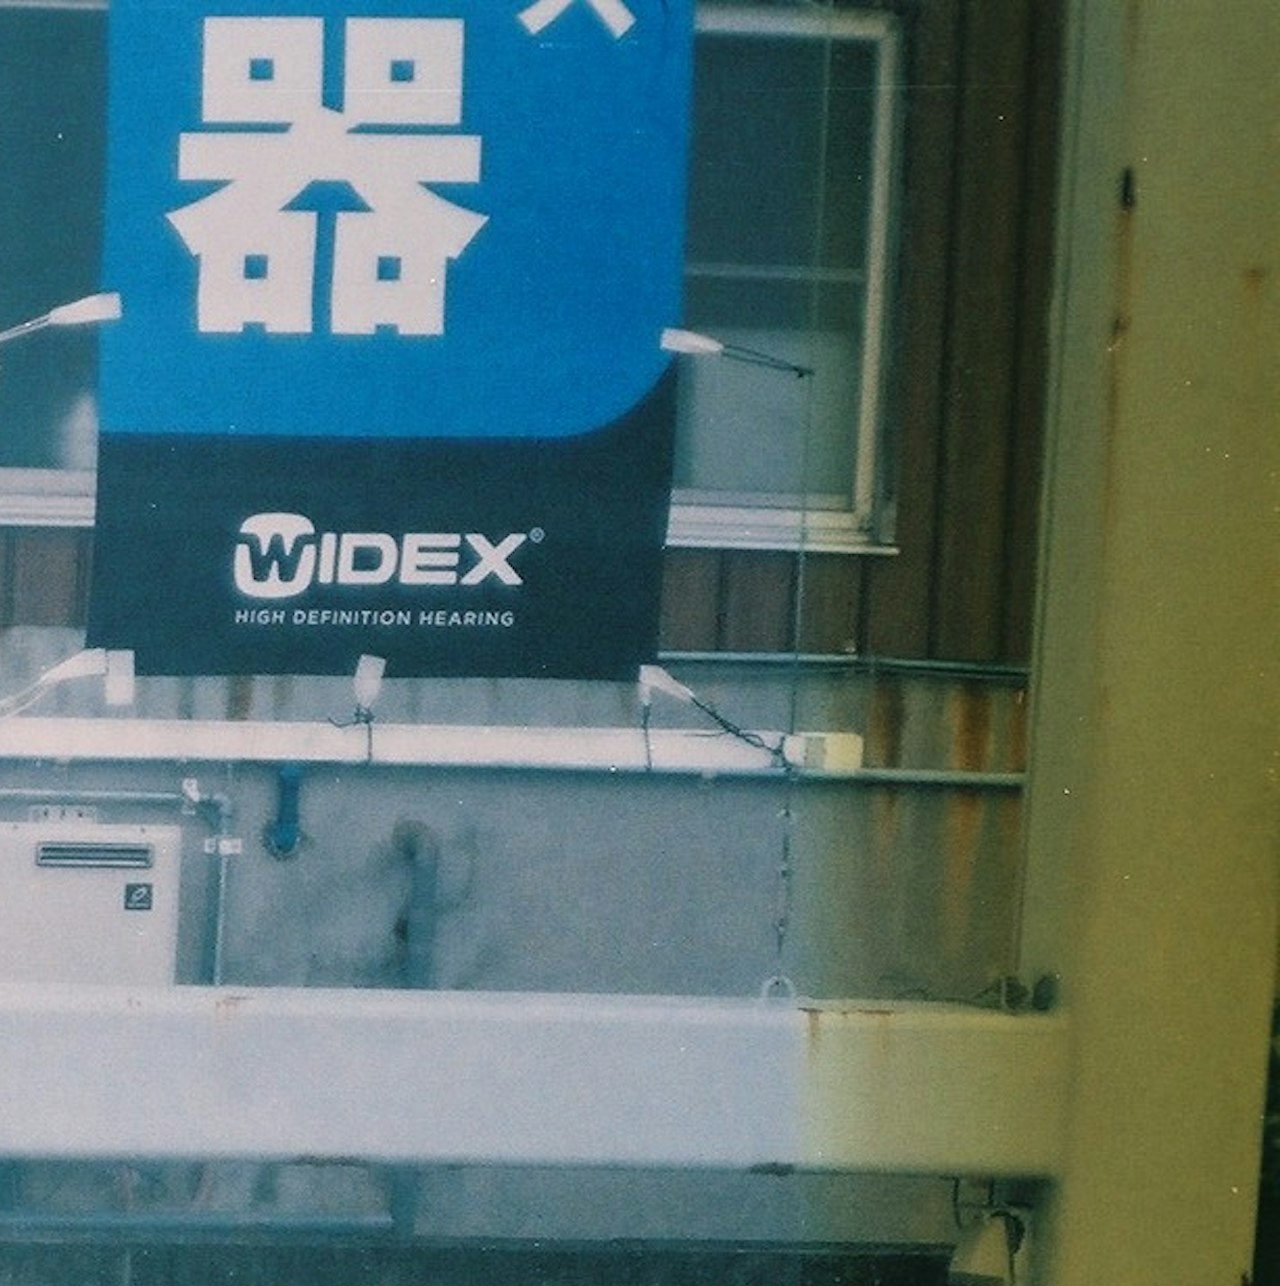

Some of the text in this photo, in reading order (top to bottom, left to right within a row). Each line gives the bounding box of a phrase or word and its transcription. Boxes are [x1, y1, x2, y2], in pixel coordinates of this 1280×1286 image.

[165, 16, 491, 336] 器
[235, 608, 515, 627] HIGH DEFINITION HEARING
